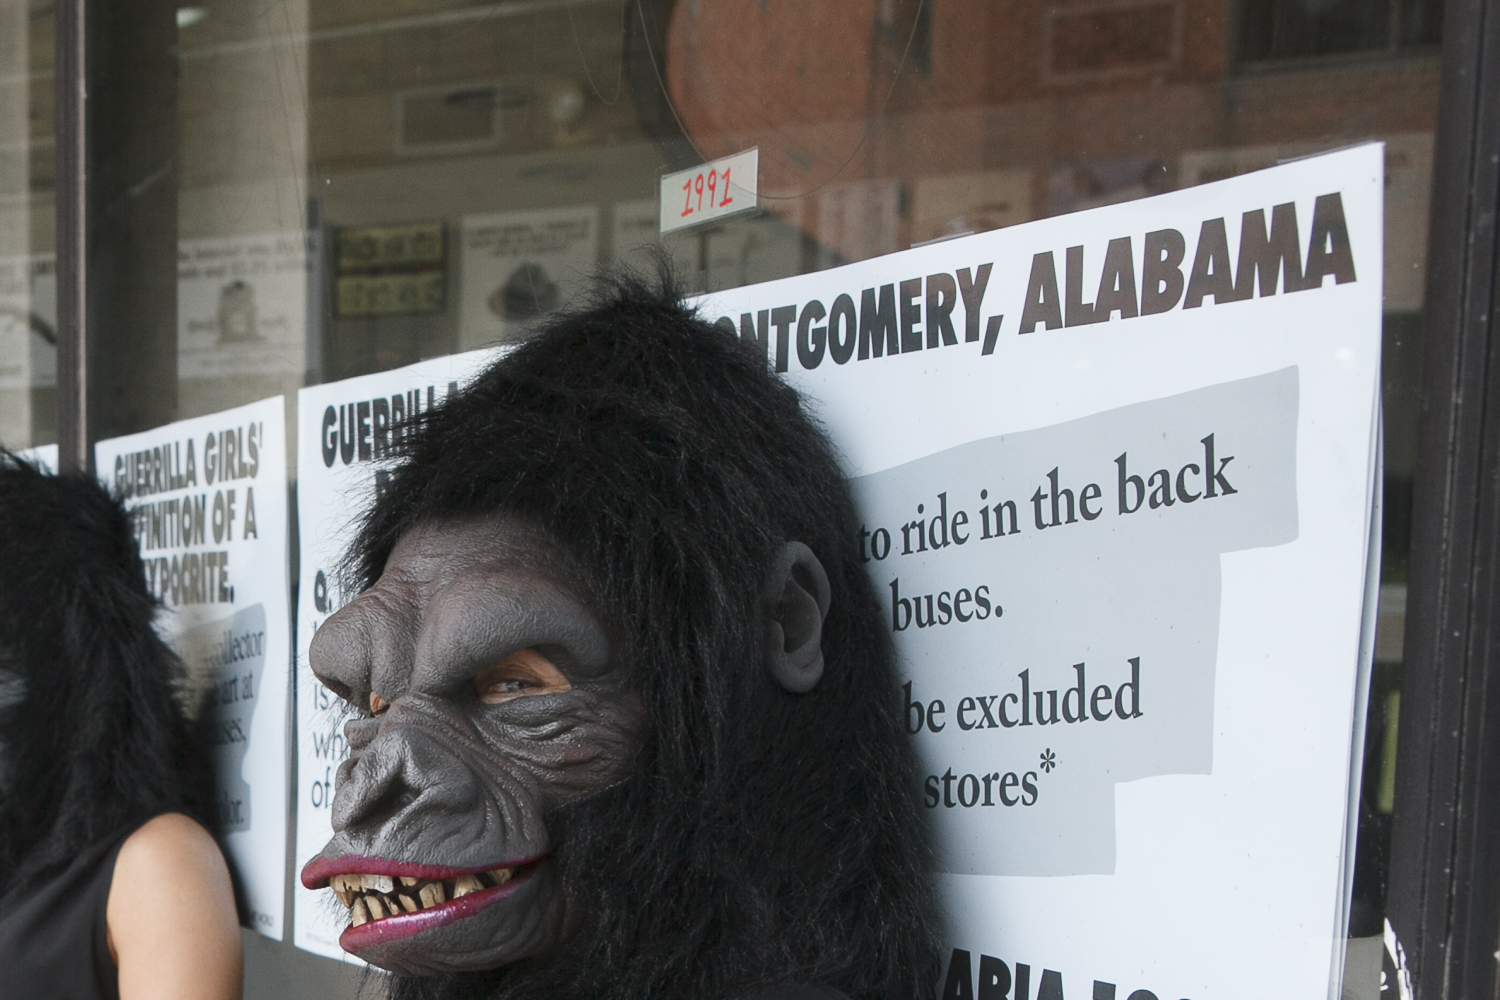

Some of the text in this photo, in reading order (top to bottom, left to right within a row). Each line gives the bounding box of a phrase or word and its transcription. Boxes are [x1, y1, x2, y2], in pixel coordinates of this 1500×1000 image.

[681, 166, 733, 217] 1991
[1018, 191, 1358, 335] ALABAMA
[212, 488, 236, 545] OF
[243, 486, 258, 541] A
[858, 432, 1238, 563] to ride in the back
[888, 577, 1004, 634] buses.
[901, 656, 1144, 736] be excluded
